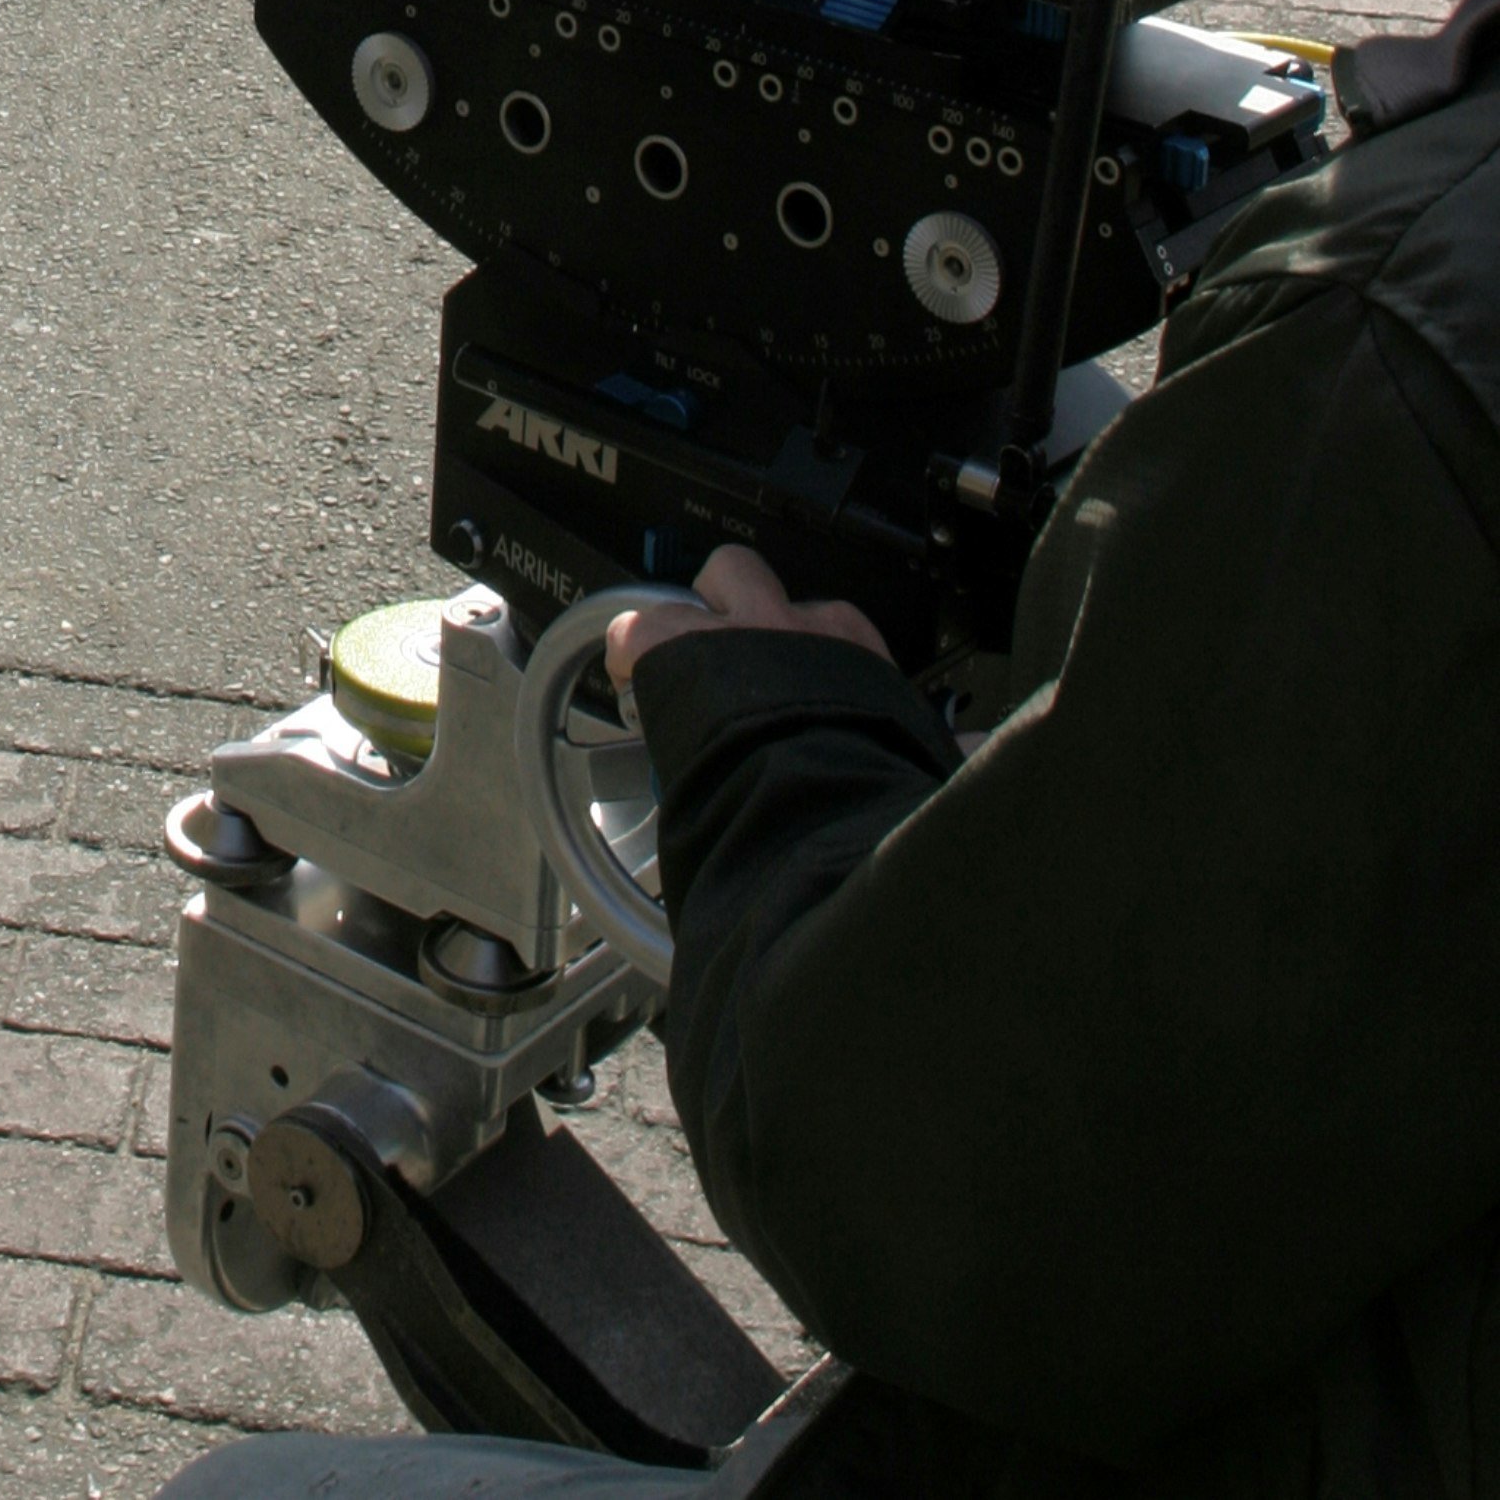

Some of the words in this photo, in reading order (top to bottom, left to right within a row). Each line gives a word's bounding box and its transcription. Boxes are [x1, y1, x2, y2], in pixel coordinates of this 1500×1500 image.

[615, 7, 632, 25] 20
[705, 34, 722, 53] 20
[750, 50, 767, 67] 40
[846, 77, 863, 95] 80
[941, 106, 964, 125] 120
[492, 532, 585, 606] ARRIHEA
